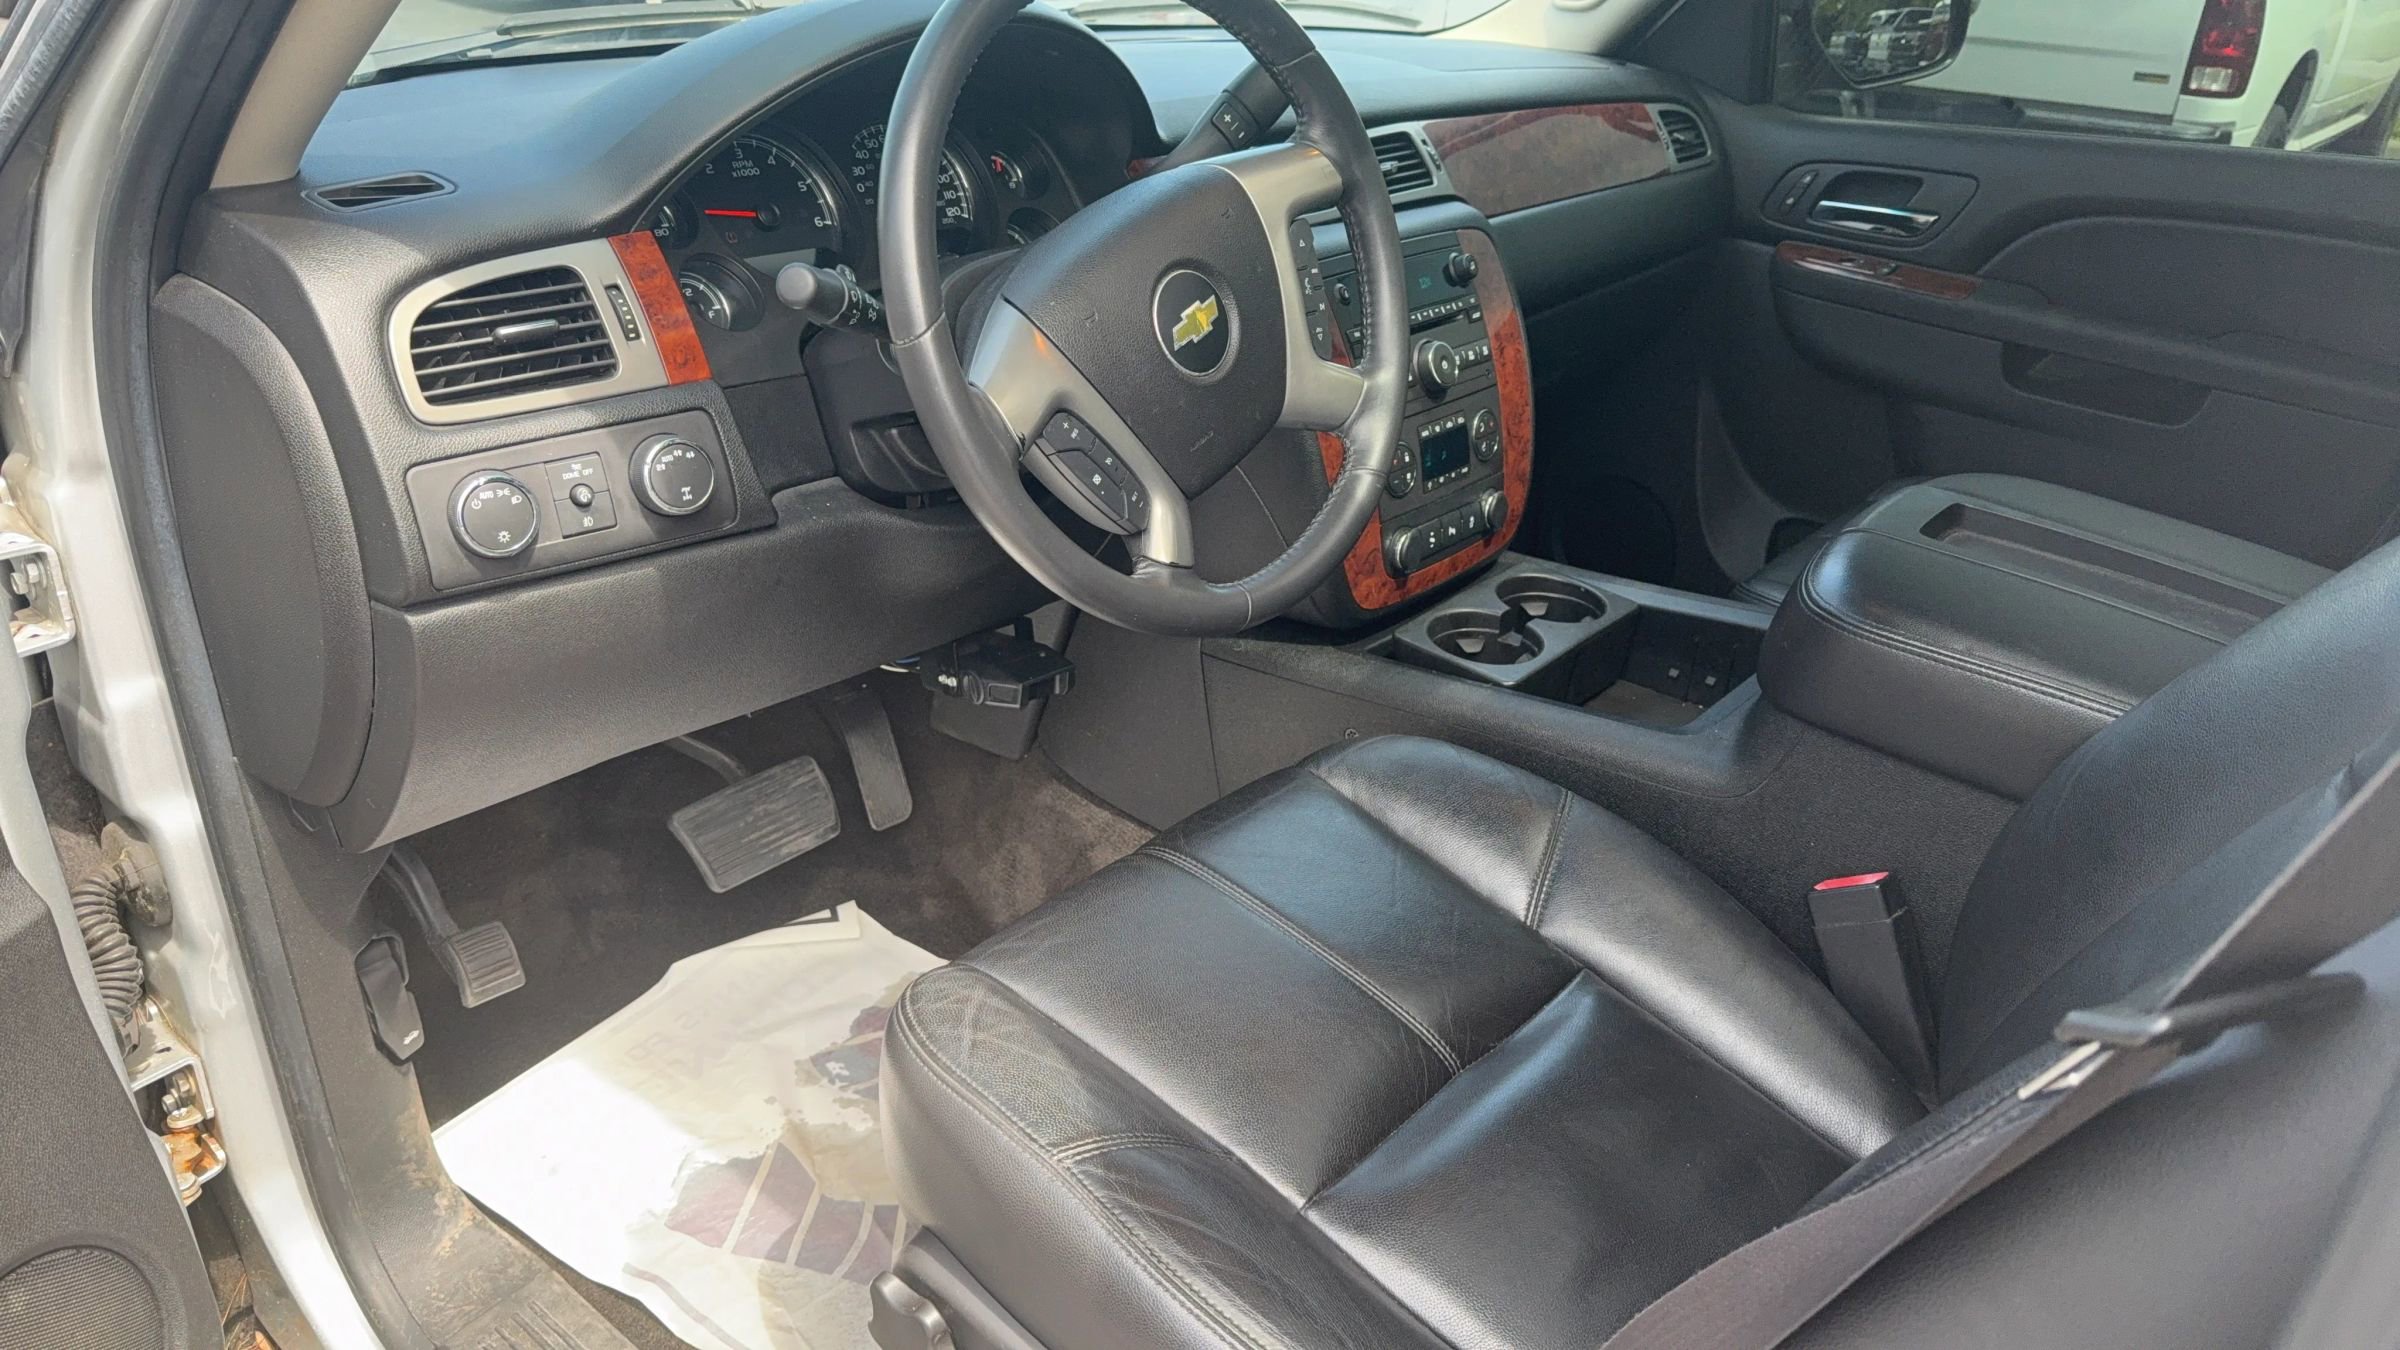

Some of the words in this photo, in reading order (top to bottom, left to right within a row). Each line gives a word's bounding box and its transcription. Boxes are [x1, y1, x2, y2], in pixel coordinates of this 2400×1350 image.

[864, 138, 879, 149] 50
[734, 148, 744, 159] 3
[855, 150, 870, 159] 40
[731, 160, 754, 168] RPM
[767, 155, 776, 165] 4
[705, 163, 715, 174] 2
[731, 167, 760, 177] x1000
[851, 166, 866, 176] 30
[937, 174, 950, 183] 00
[797, 181, 807, 192] 5
[943, 190, 957, 200] 110
[945, 206, 961, 217] 120
[814, 216, 824, 227] 6
[654, 228, 669, 237] 80
